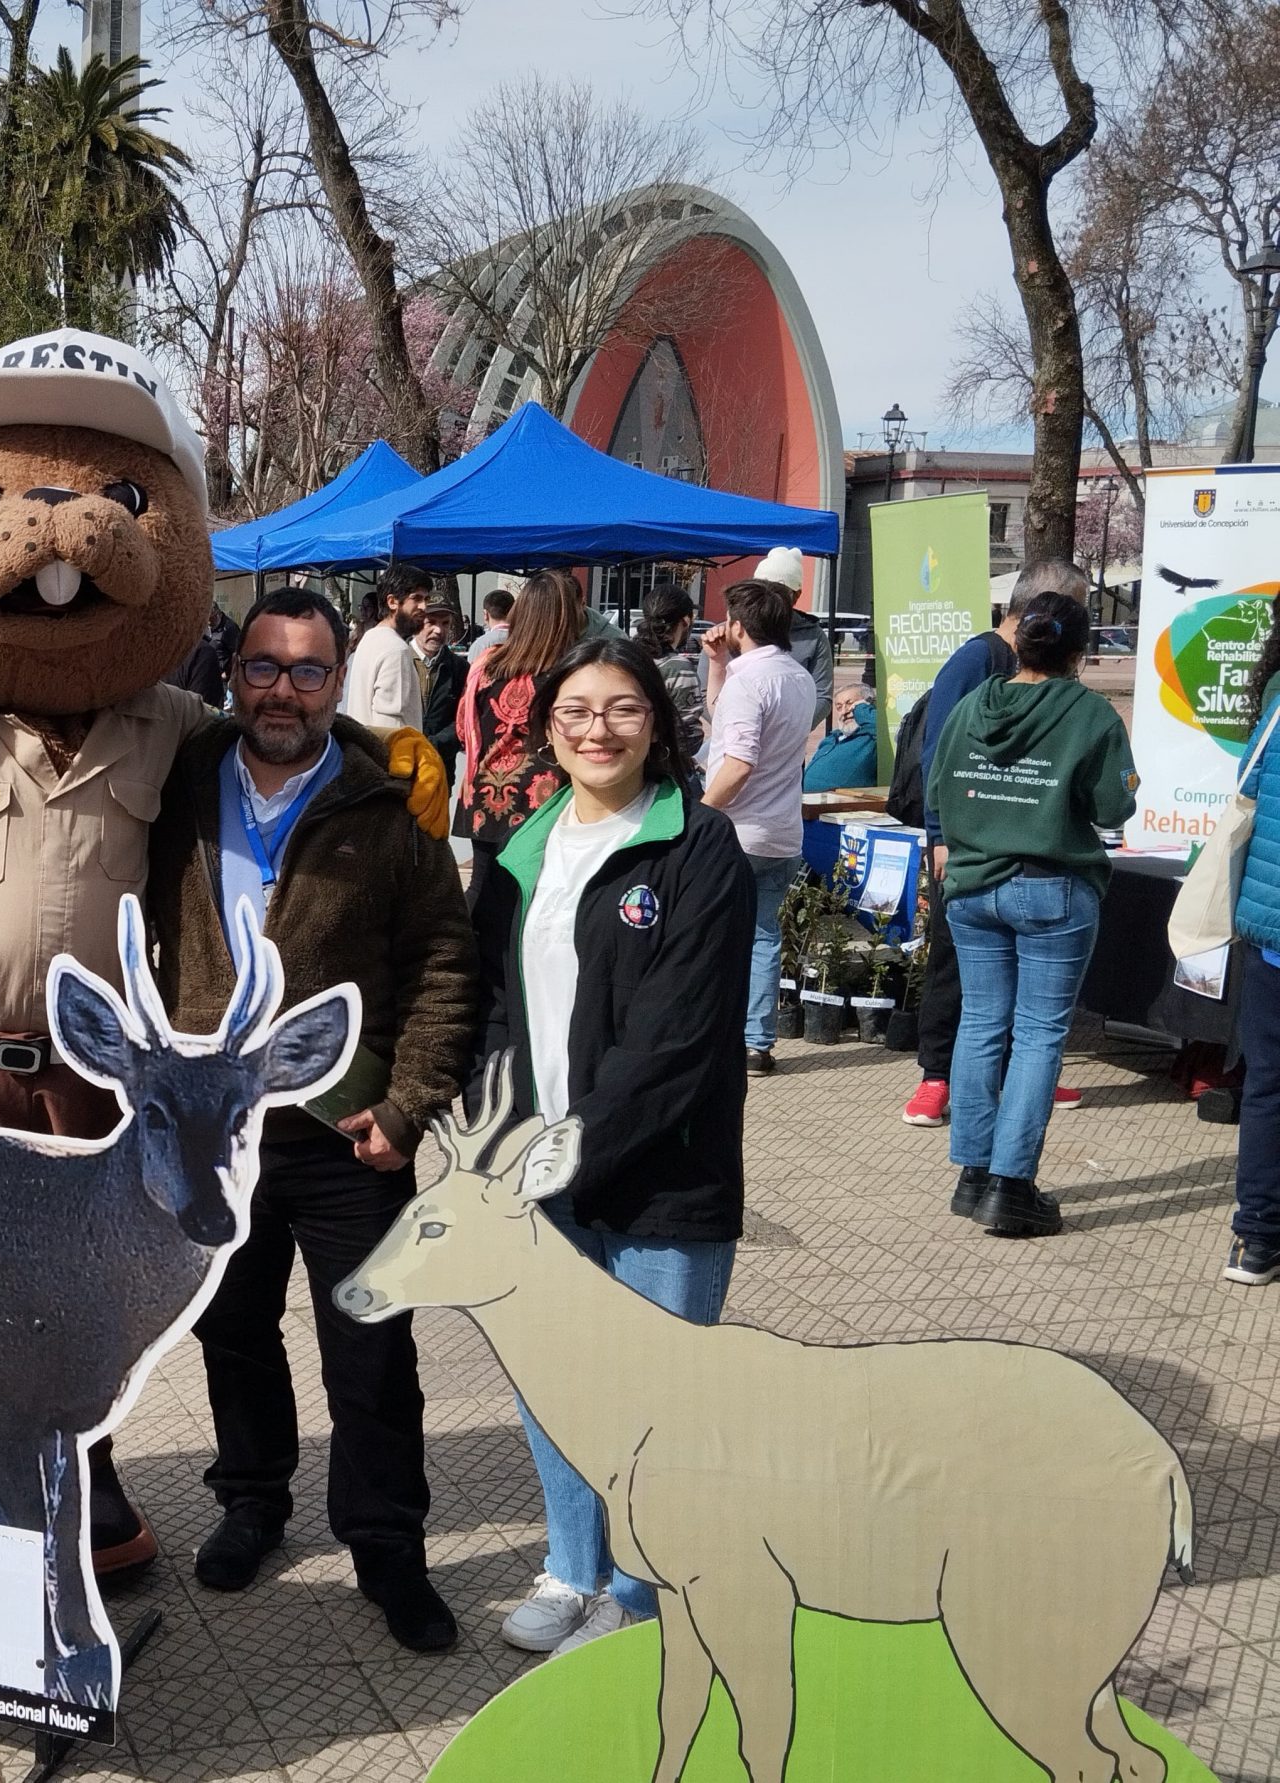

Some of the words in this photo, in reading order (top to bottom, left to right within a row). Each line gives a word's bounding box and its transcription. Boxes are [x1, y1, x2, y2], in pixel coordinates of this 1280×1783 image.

[1160, 520, 1197, 529] Universidad
[1199, 520, 1207, 528] de
[1208, 519, 1249, 530] Concepción
[909, 600, 942, 613] Ingeniería
[944, 601, 954, 609] en
[889, 612, 972, 634] RECURSOS
[885, 634, 976, 657] NATURAL
[1207, 639, 1245, 651] Centro
[1246, 639, 1261, 651] de
[1192, 716, 1239, 725] Universidad
[953, 770, 1002, 781] UNIVERSIDAD
[1003, 775, 1013, 783] DE
[1010, 765, 1039, 776] Silvestre
[977, 791, 1039, 805] faunasilvestreudec
[1143, 808, 1217, 837] Rehab
